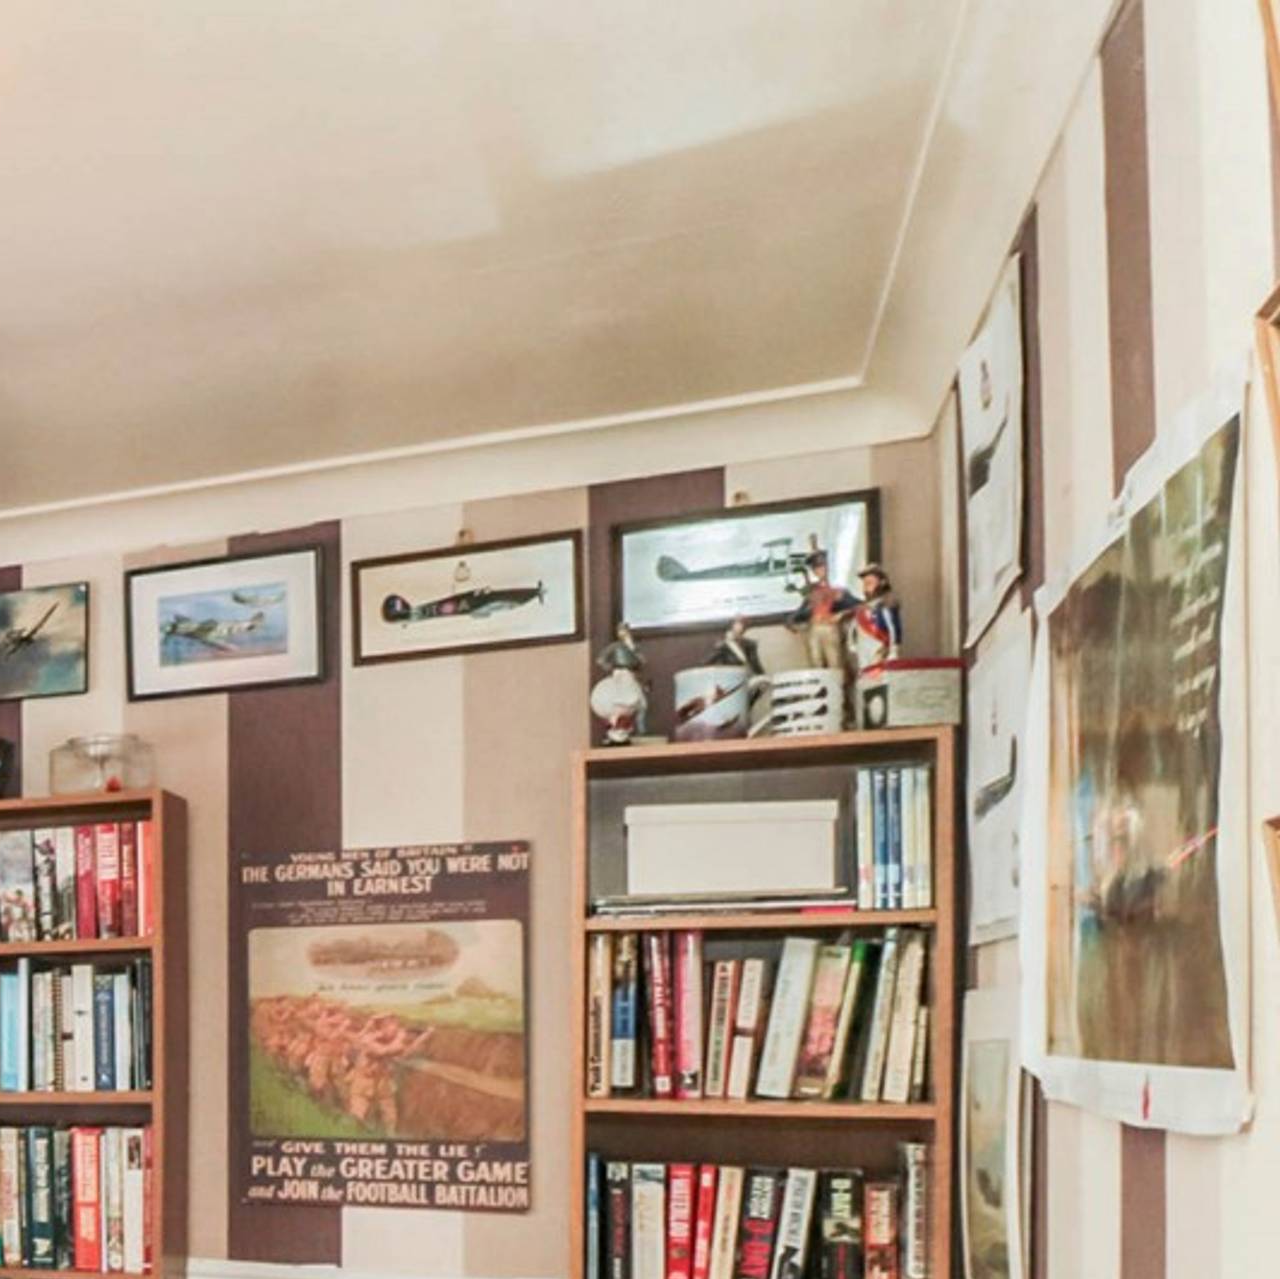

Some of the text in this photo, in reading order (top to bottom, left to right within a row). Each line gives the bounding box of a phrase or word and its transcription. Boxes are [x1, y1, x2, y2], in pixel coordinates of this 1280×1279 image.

[242, 853, 529, 883] THE GERMANS SAID YOU WERE NOT
[290, 852, 336, 863] YOUNG
[341, 850, 370, 861] MEN
[375, 848, 390, 859] OF
[327, 876, 433, 896] IN EARNEST
[281, 1141, 326, 1154] GIVE
[334, 1142, 387, 1156] THEM
[395, 1143, 431, 1157] THE
[251, 1155, 529, 1184] PLAY the GREATER GAME
[247, 1178, 529, 1208] and JOIN the FOOTBALL BATTALION
[830, 1178, 852, 1219] D-DAY
